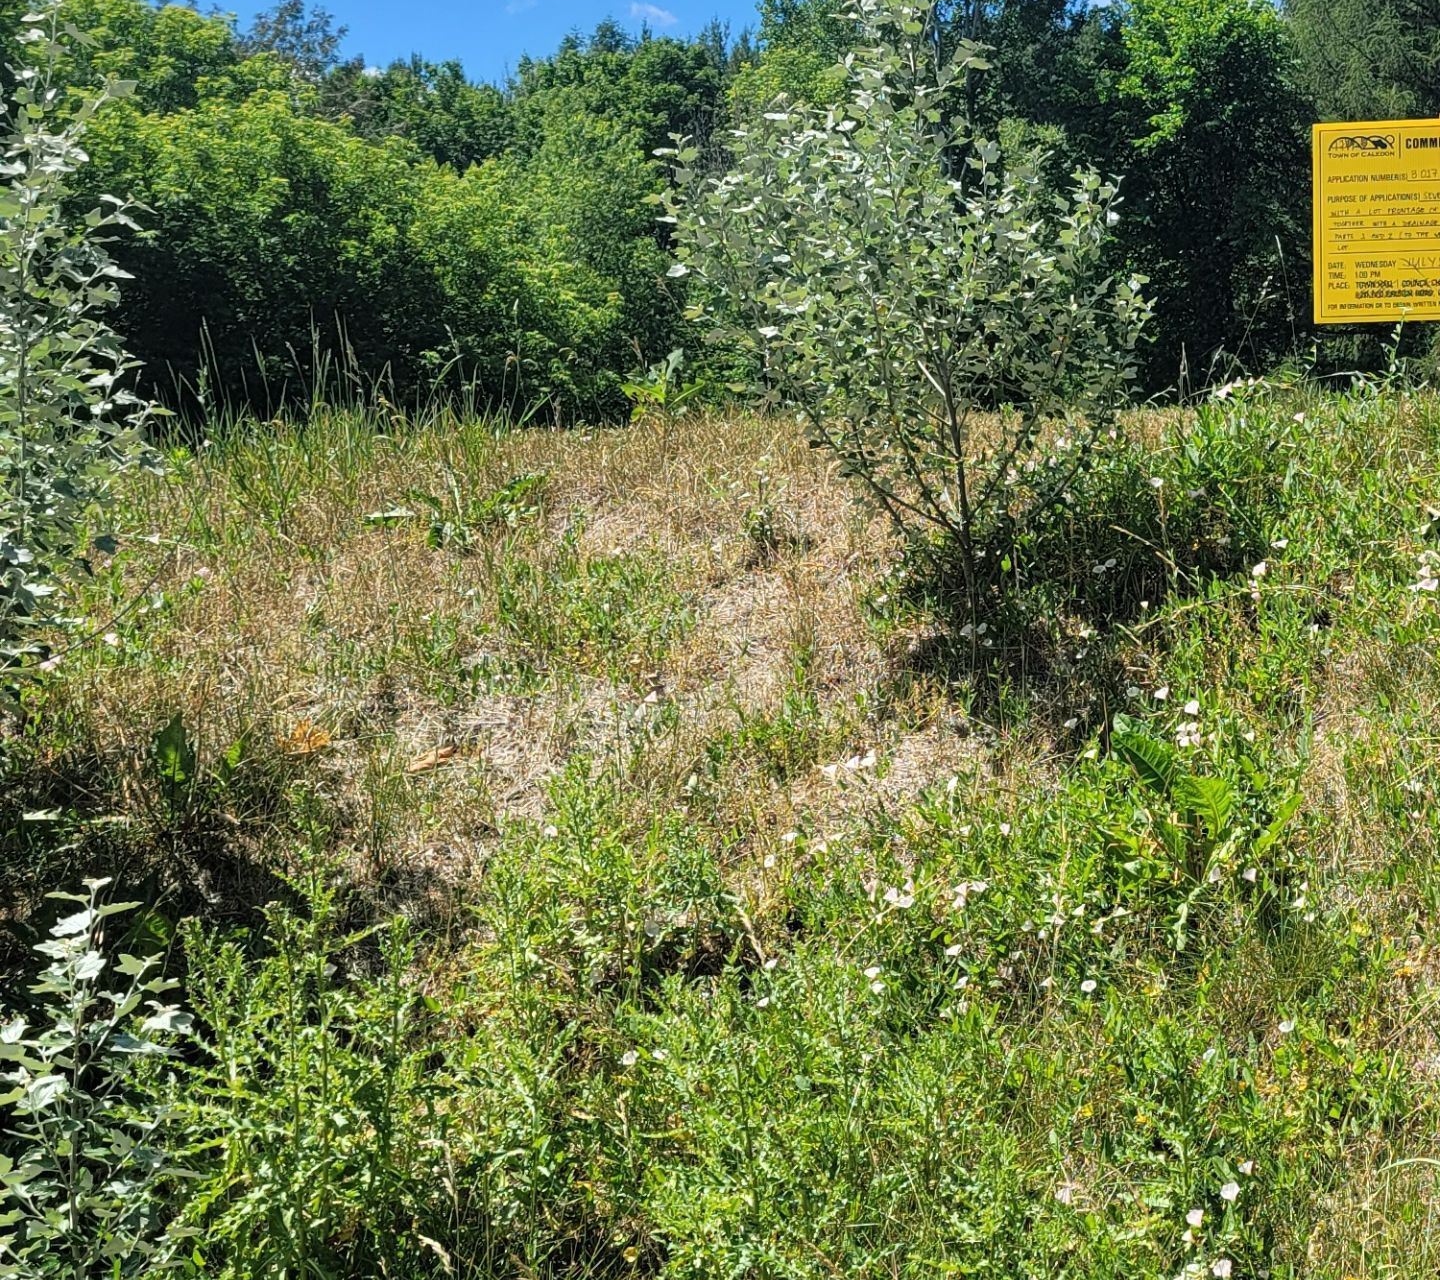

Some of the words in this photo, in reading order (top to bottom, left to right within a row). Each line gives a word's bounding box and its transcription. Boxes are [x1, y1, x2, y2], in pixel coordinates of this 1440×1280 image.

[1327, 175, 1369, 184] APPLICATION
[1327, 195, 1358, 204] PURPOSE
[1359, 194, 1368, 203] OF
[1355, 260, 1397, 269] WEDNESDAY
[1370, 270, 1381, 278] PM
